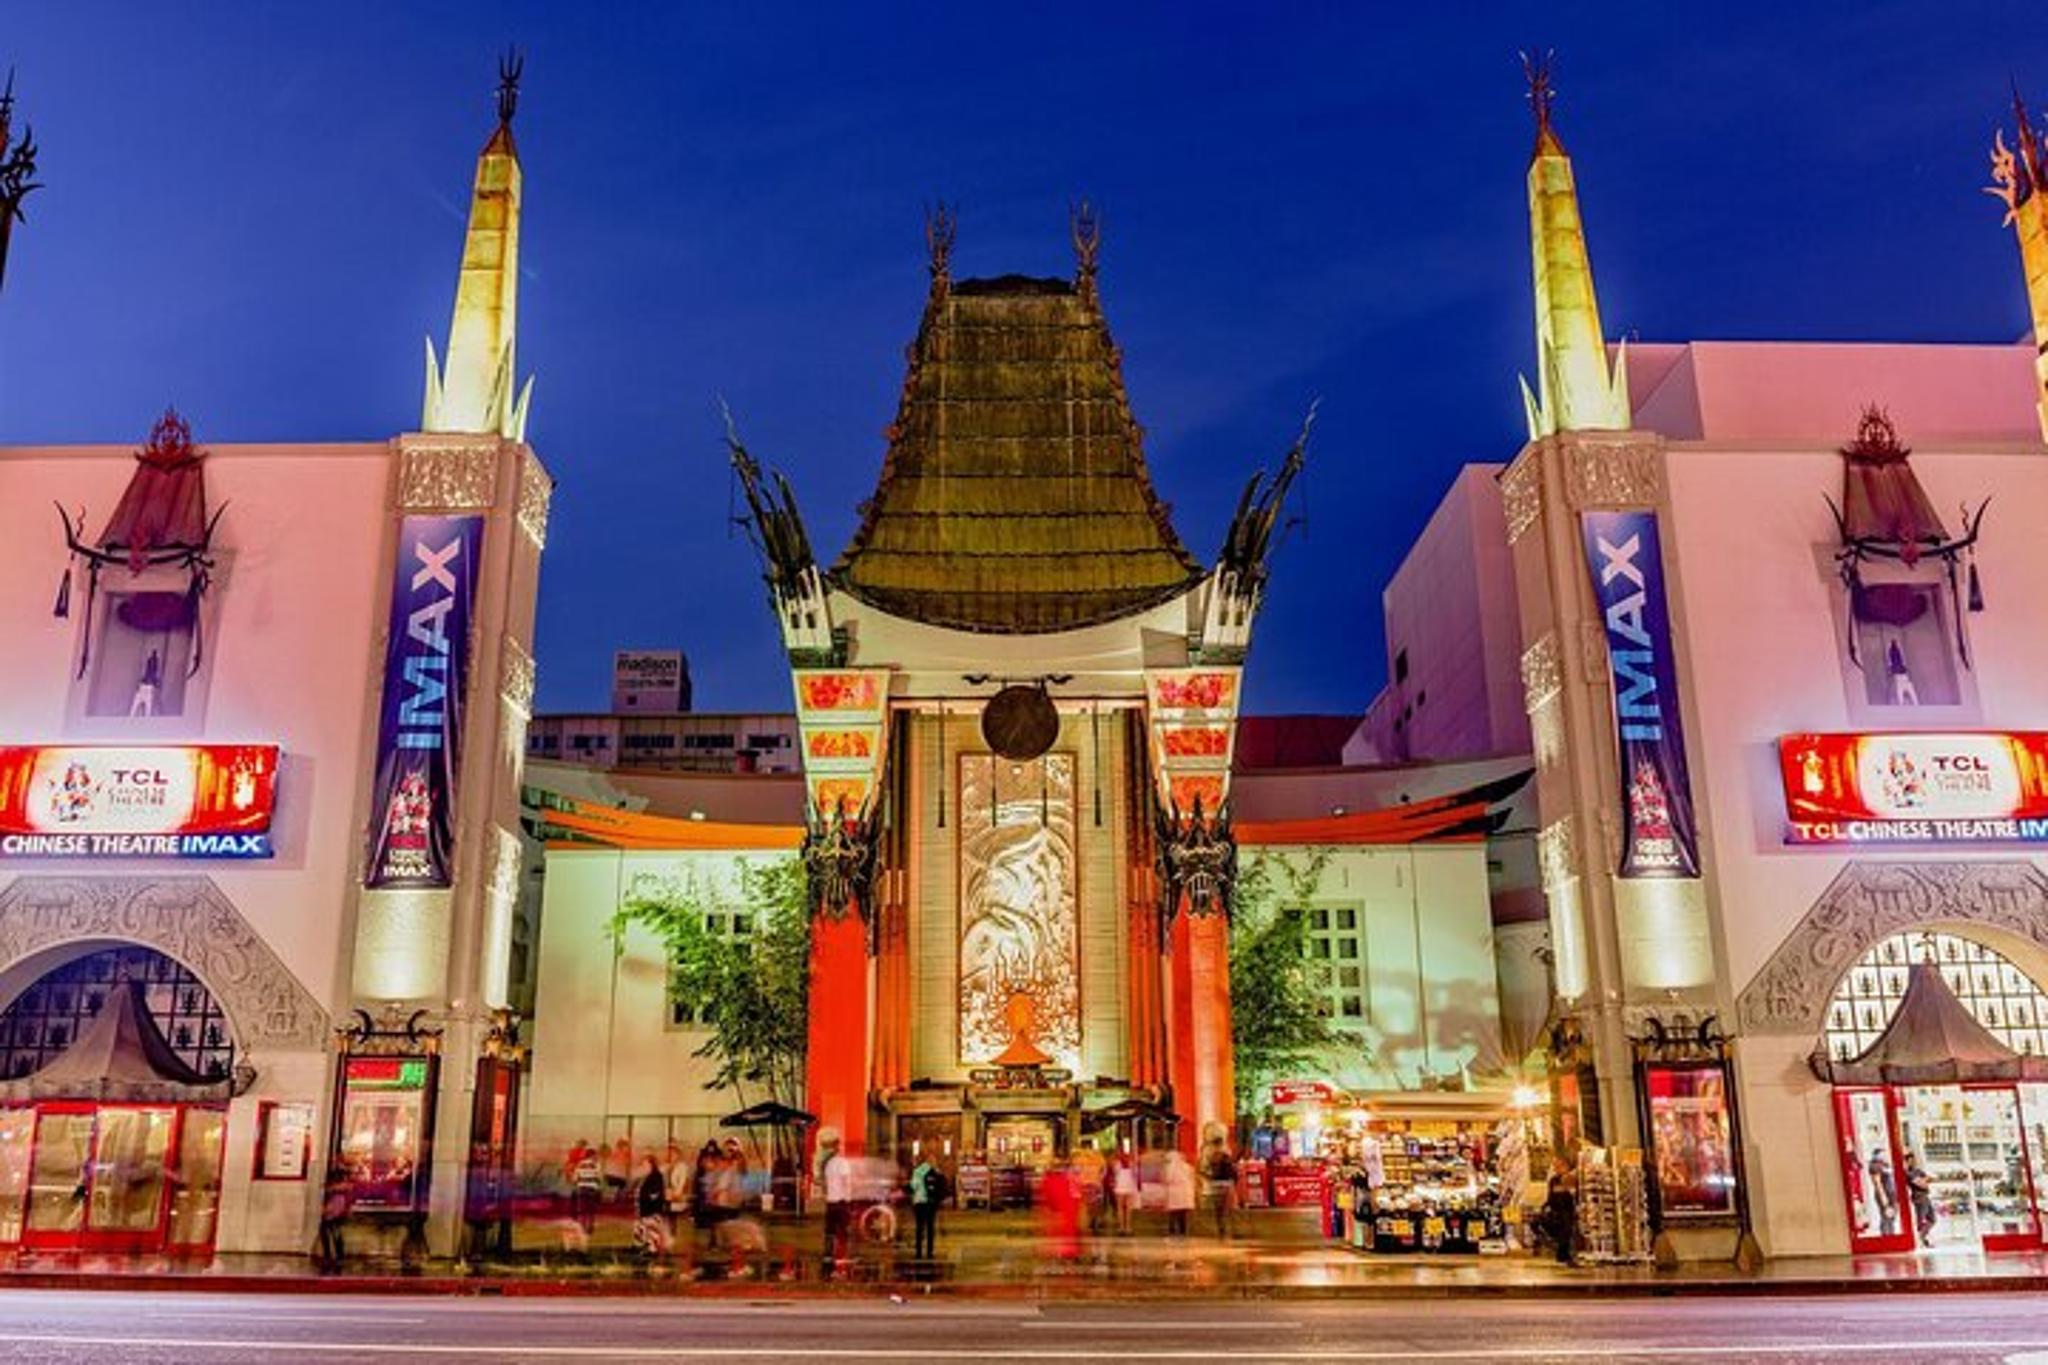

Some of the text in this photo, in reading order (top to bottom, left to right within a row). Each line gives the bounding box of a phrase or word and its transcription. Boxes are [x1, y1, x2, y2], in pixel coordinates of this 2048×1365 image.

[398, 536, 461, 748] IMAX
[1597, 532, 1662, 740] IMAX
[1932, 755, 1989, 771] TCL
[112, 769, 168, 785] TCL
[1796, 823, 1847, 839] TCL
[1849, 822, 1934, 838] CHINESE
[1934, 820, 2020, 838] THEATRE
[2, 834, 264, 854] CHINESE THEATRE IMAX
[383, 863, 431, 877] IMAX
